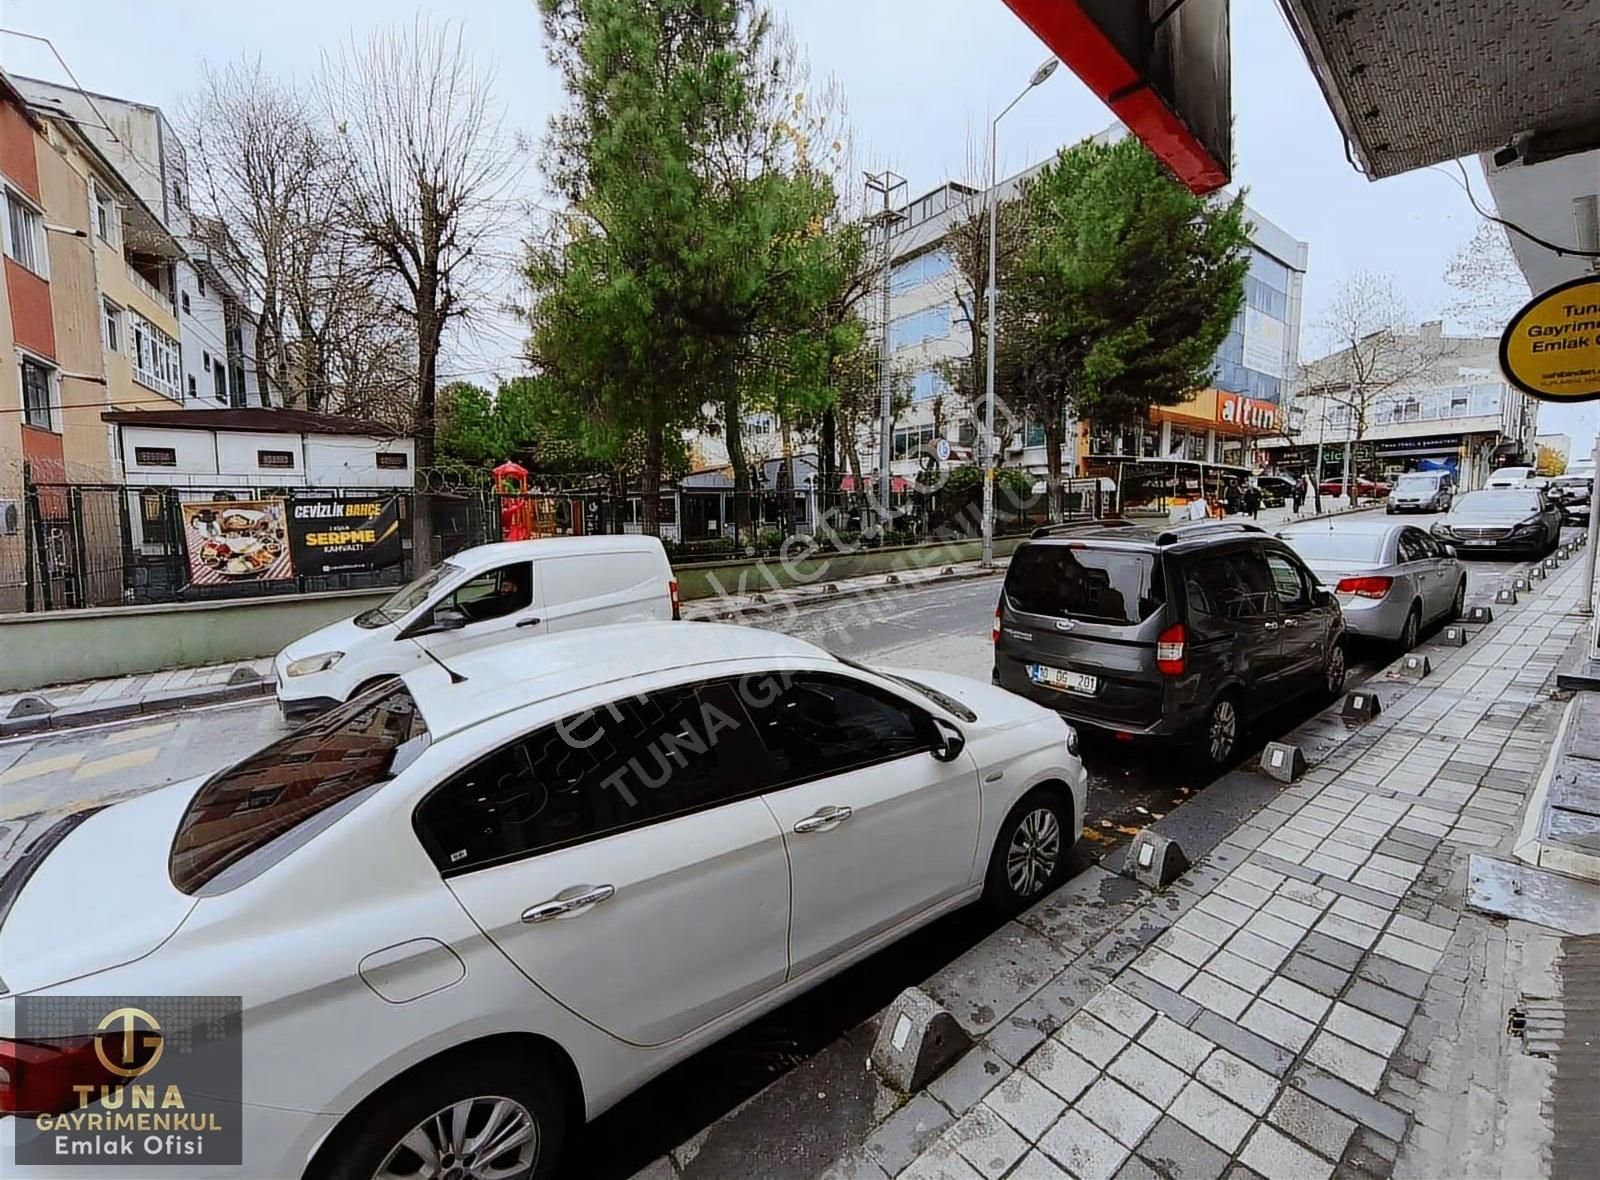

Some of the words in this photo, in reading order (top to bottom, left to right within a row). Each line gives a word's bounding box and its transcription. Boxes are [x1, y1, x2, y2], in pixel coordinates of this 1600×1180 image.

[1532, 336, 1591, 353] Emlak
[294, 501, 344, 518] CEVİZLİK
[345, 503, 382, 519] BAHÇE
[305, 529, 376, 546] SERPME
